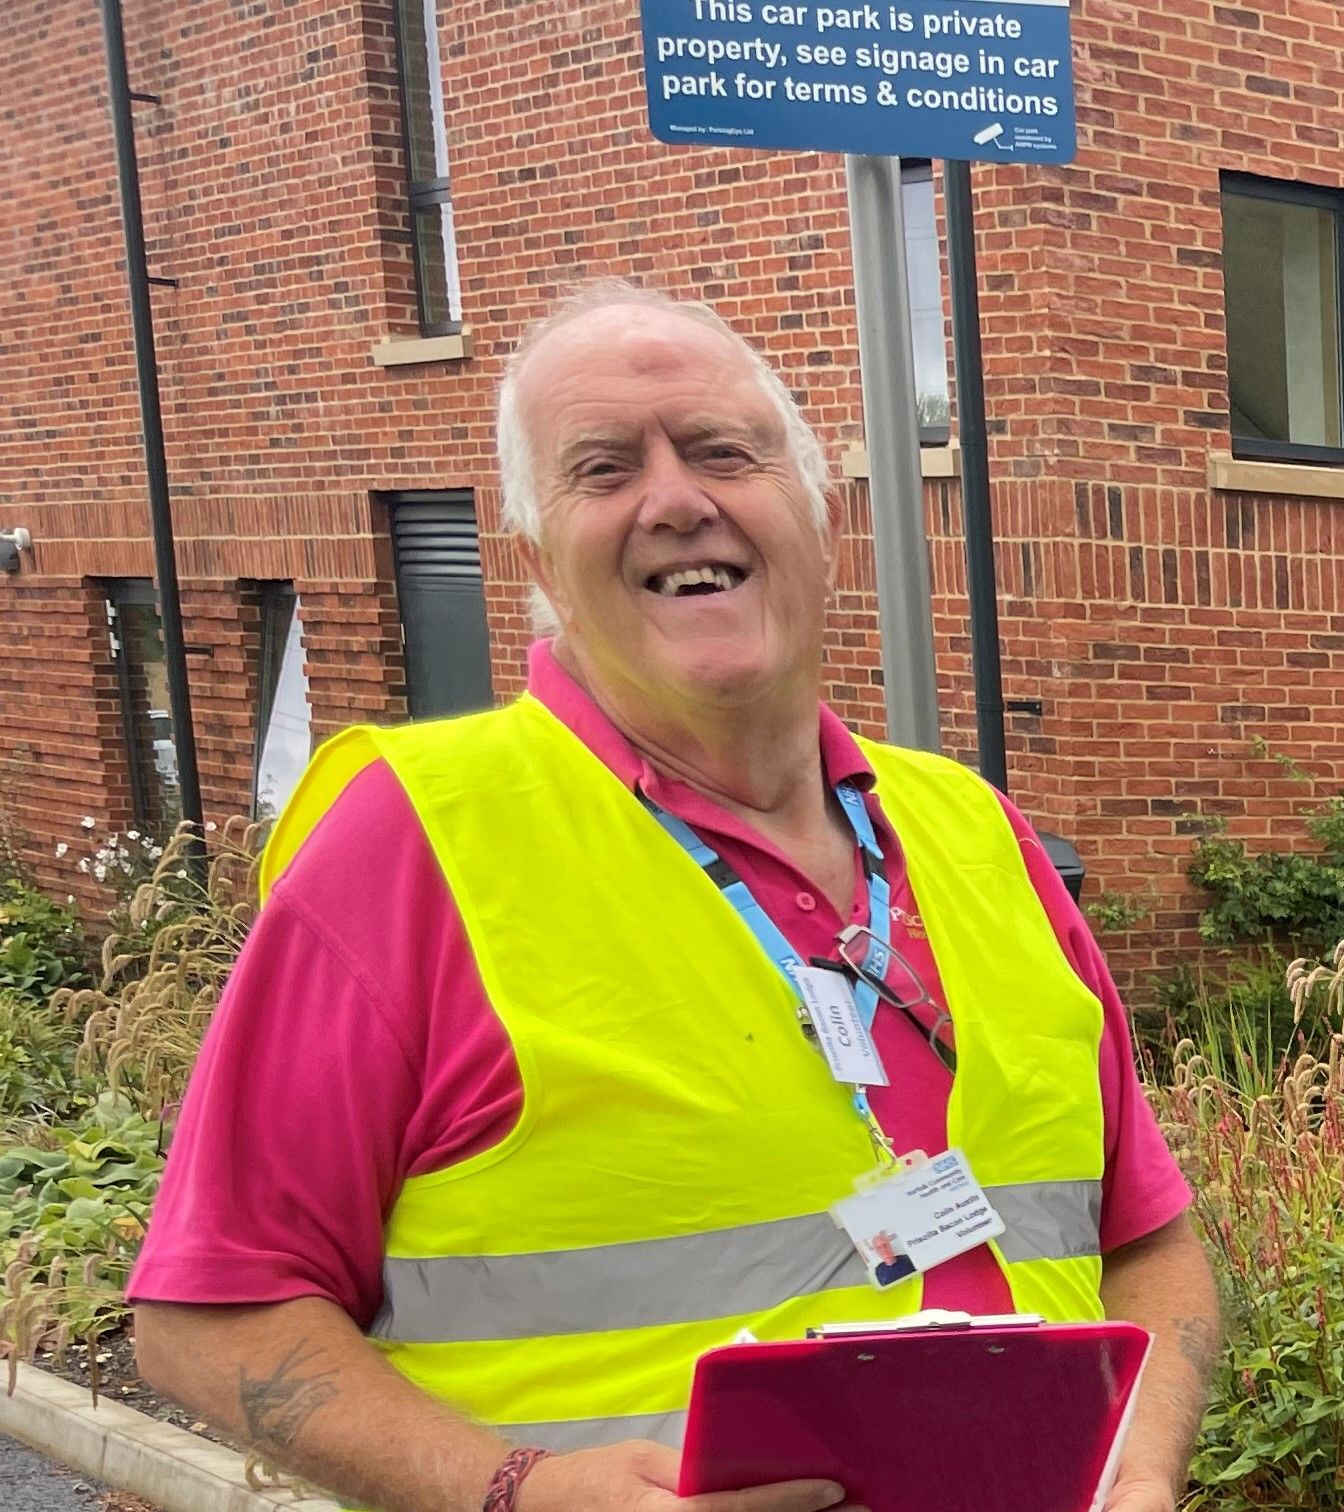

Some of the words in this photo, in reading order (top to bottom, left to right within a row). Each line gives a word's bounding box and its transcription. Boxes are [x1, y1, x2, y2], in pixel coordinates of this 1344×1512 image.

[693, 0, 753, 23] This
[761, 4, 807, 25] car
[817, 5, 881, 33] park
[889, 6, 914, 32] is
[924, 10, 1022, 39] private
[657, 37, 788, 68] property,
[796, 44, 847, 66] see
[856, 43, 970, 78] signage
[979, 50, 1005, 75] in
[1014, 57, 1059, 78] car
[662, 71, 728, 100] park
[735, 73, 776, 99] for
[784, 76, 867, 104] terms
[877, 80, 898, 106] &
[907, 86, 1058, 116] conditions
[829, 1005, 851, 1047] Colin
